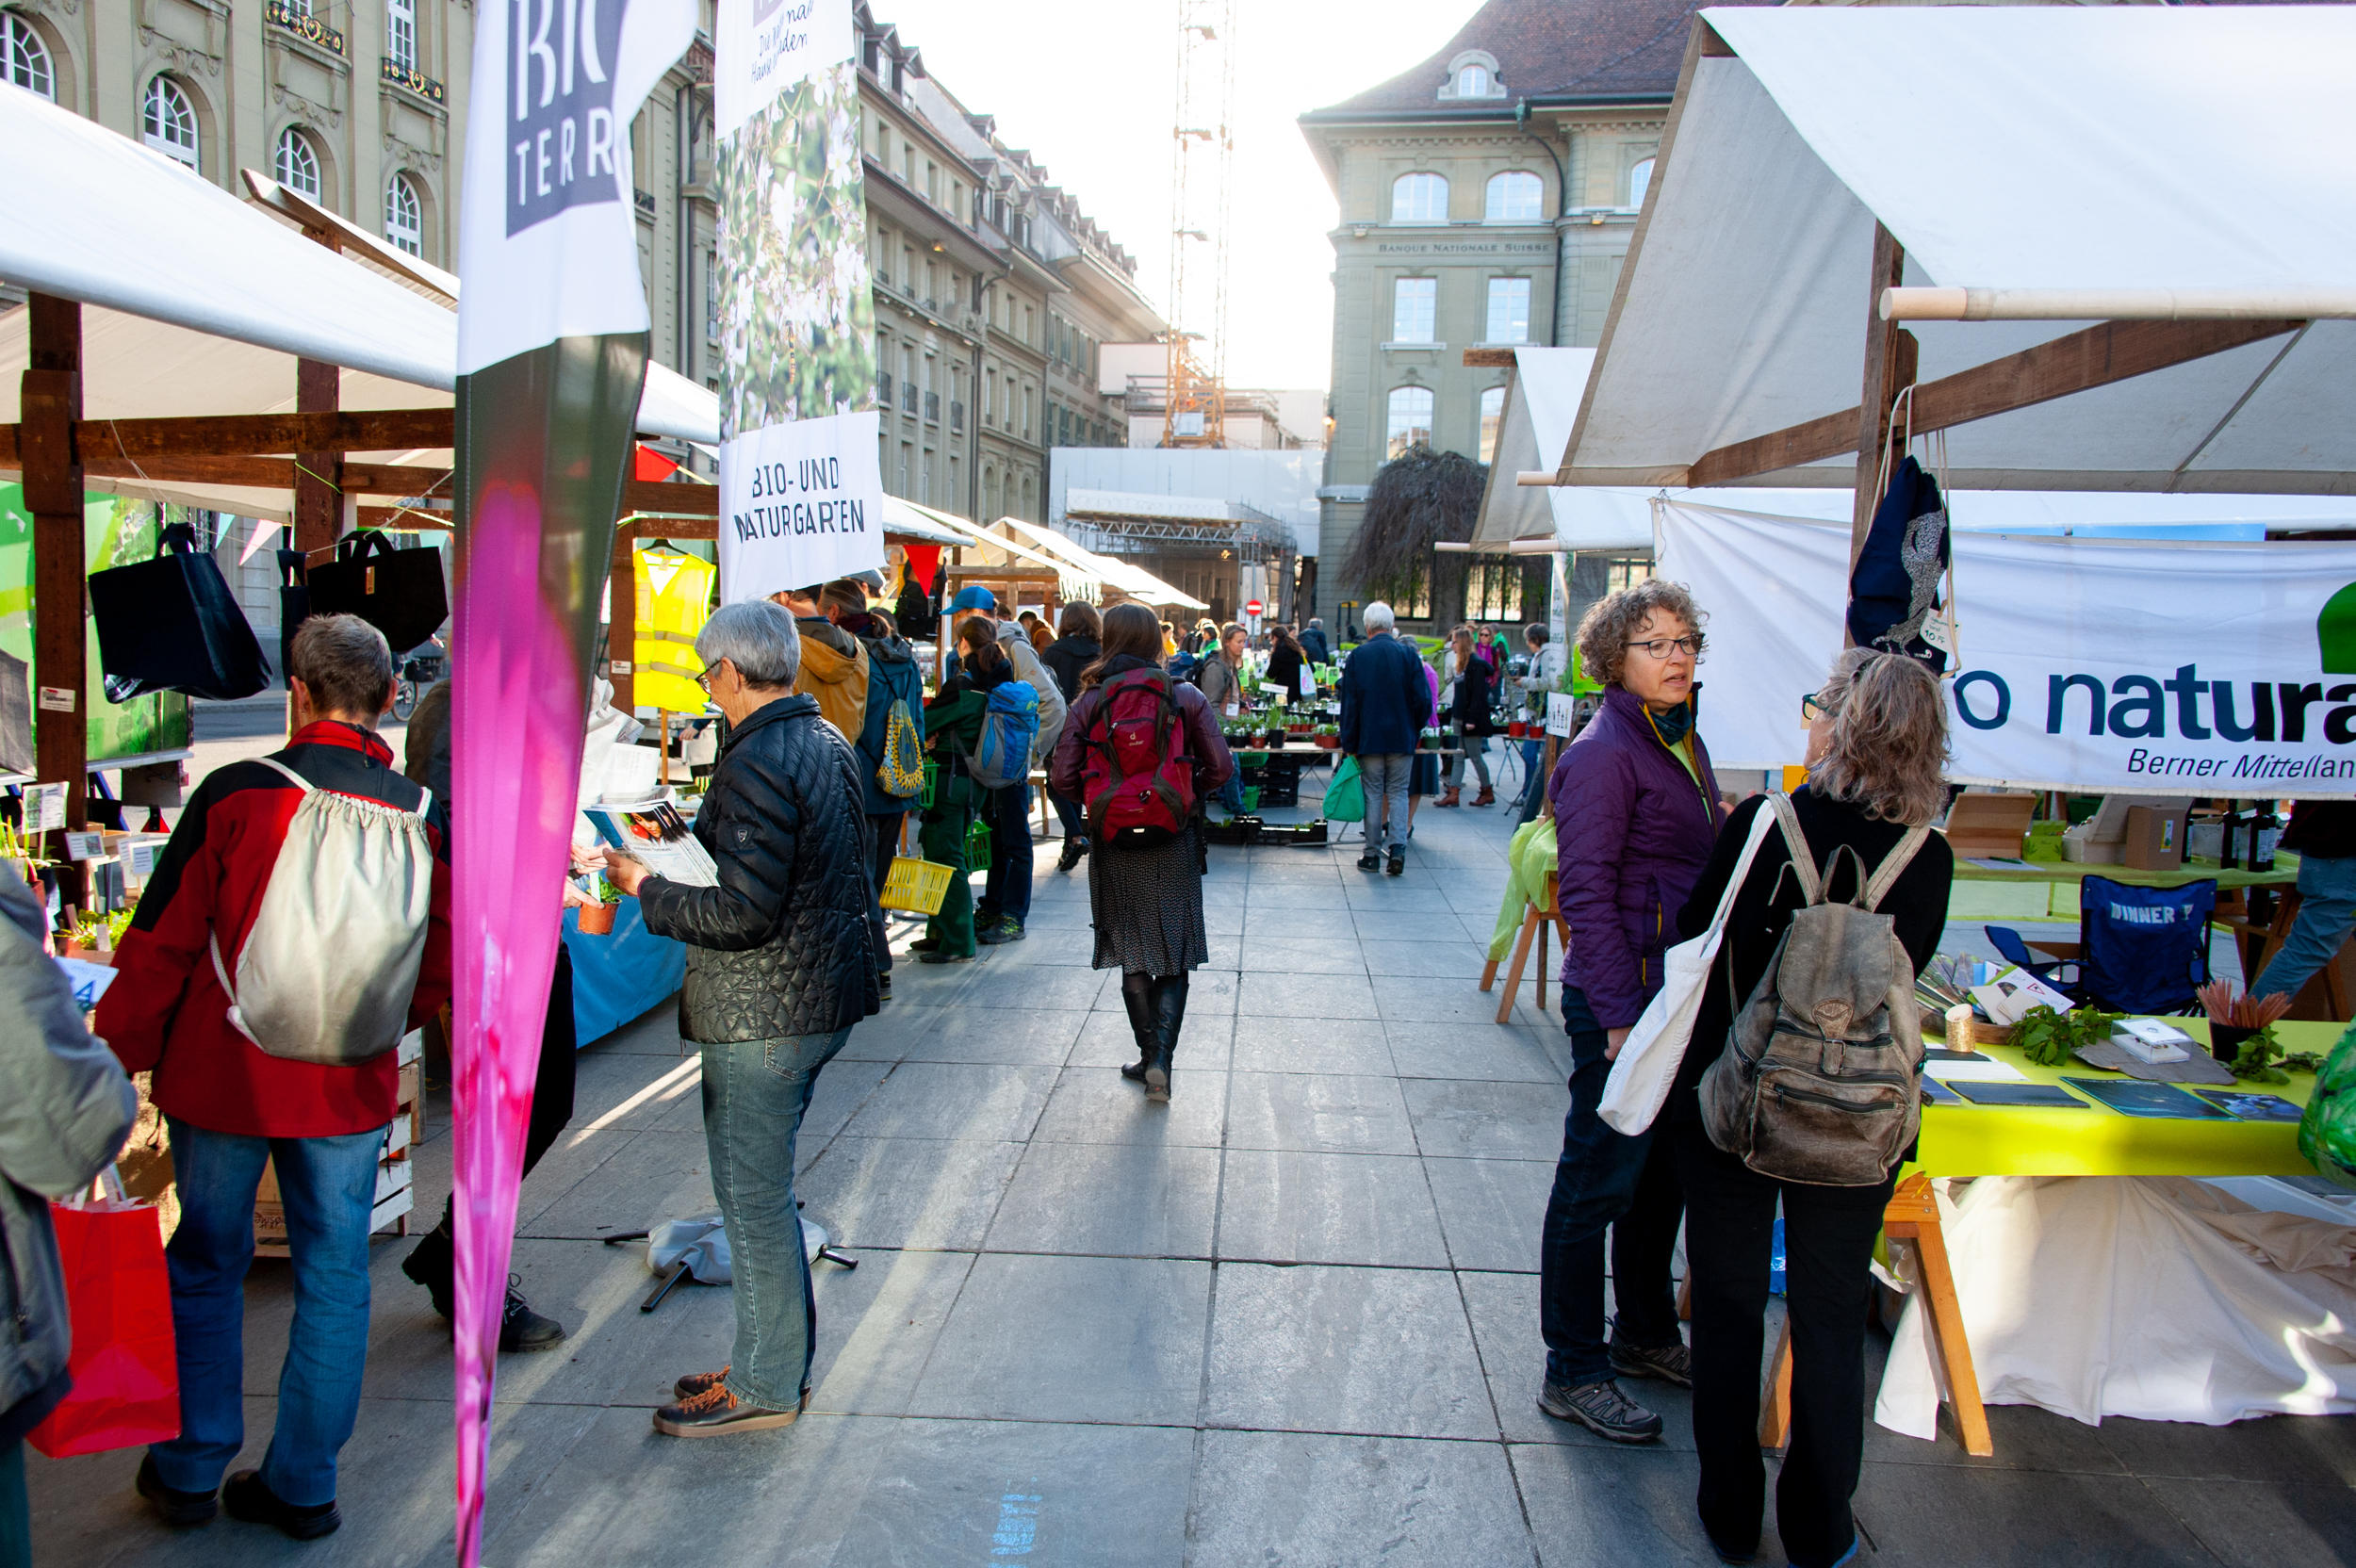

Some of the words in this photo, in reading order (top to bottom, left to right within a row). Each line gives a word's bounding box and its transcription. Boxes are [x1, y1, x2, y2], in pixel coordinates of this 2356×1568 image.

[1379, 244, 1427, 253] BANQUE
[1432, 244, 1497, 253] NATIONALE
[1504, 243, 1549, 252] SUISSE
[799, 457, 839, 492] UND
[2127, 748, 2228, 778] Berner
